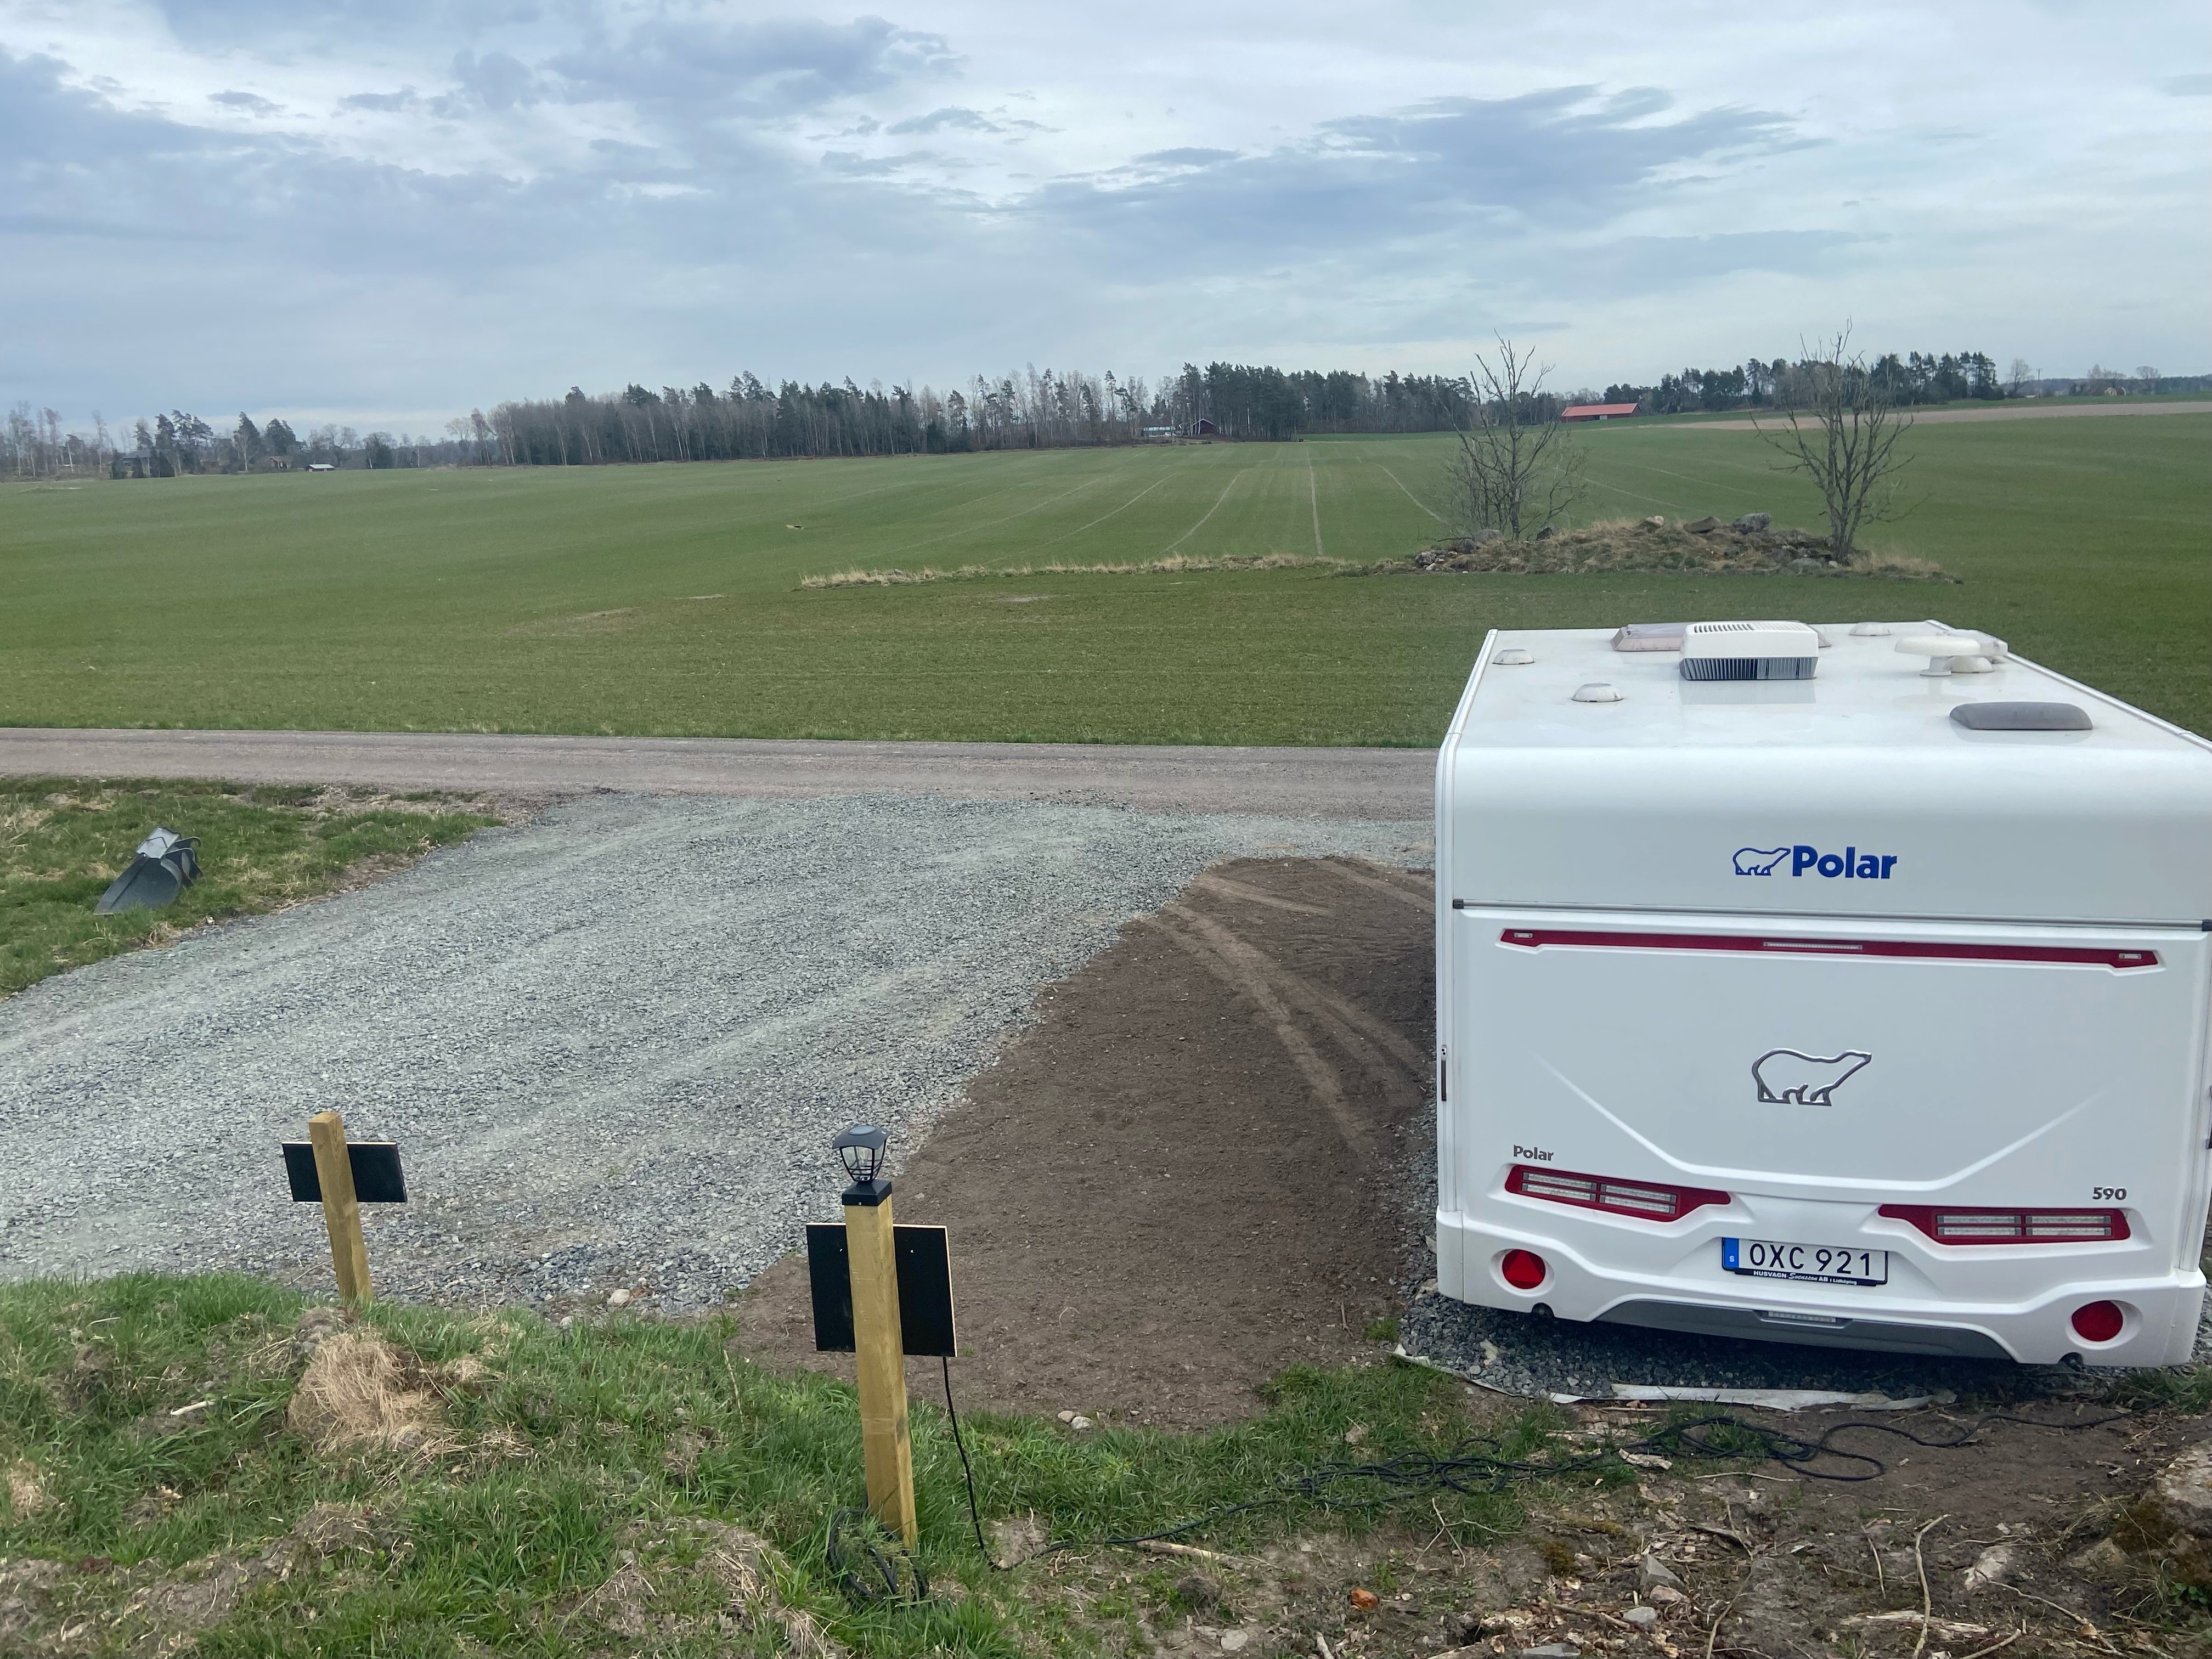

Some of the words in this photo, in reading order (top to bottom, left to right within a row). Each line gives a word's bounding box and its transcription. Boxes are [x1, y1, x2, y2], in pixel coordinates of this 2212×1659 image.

[1792, 845, 1898, 879] Polar
[1513, 1144, 1554, 1161] Polar
[2092, 1186, 2127, 1200] 590
[1750, 1243, 1805, 1269] OXC
[1815, 1249, 1870, 1276] 921
